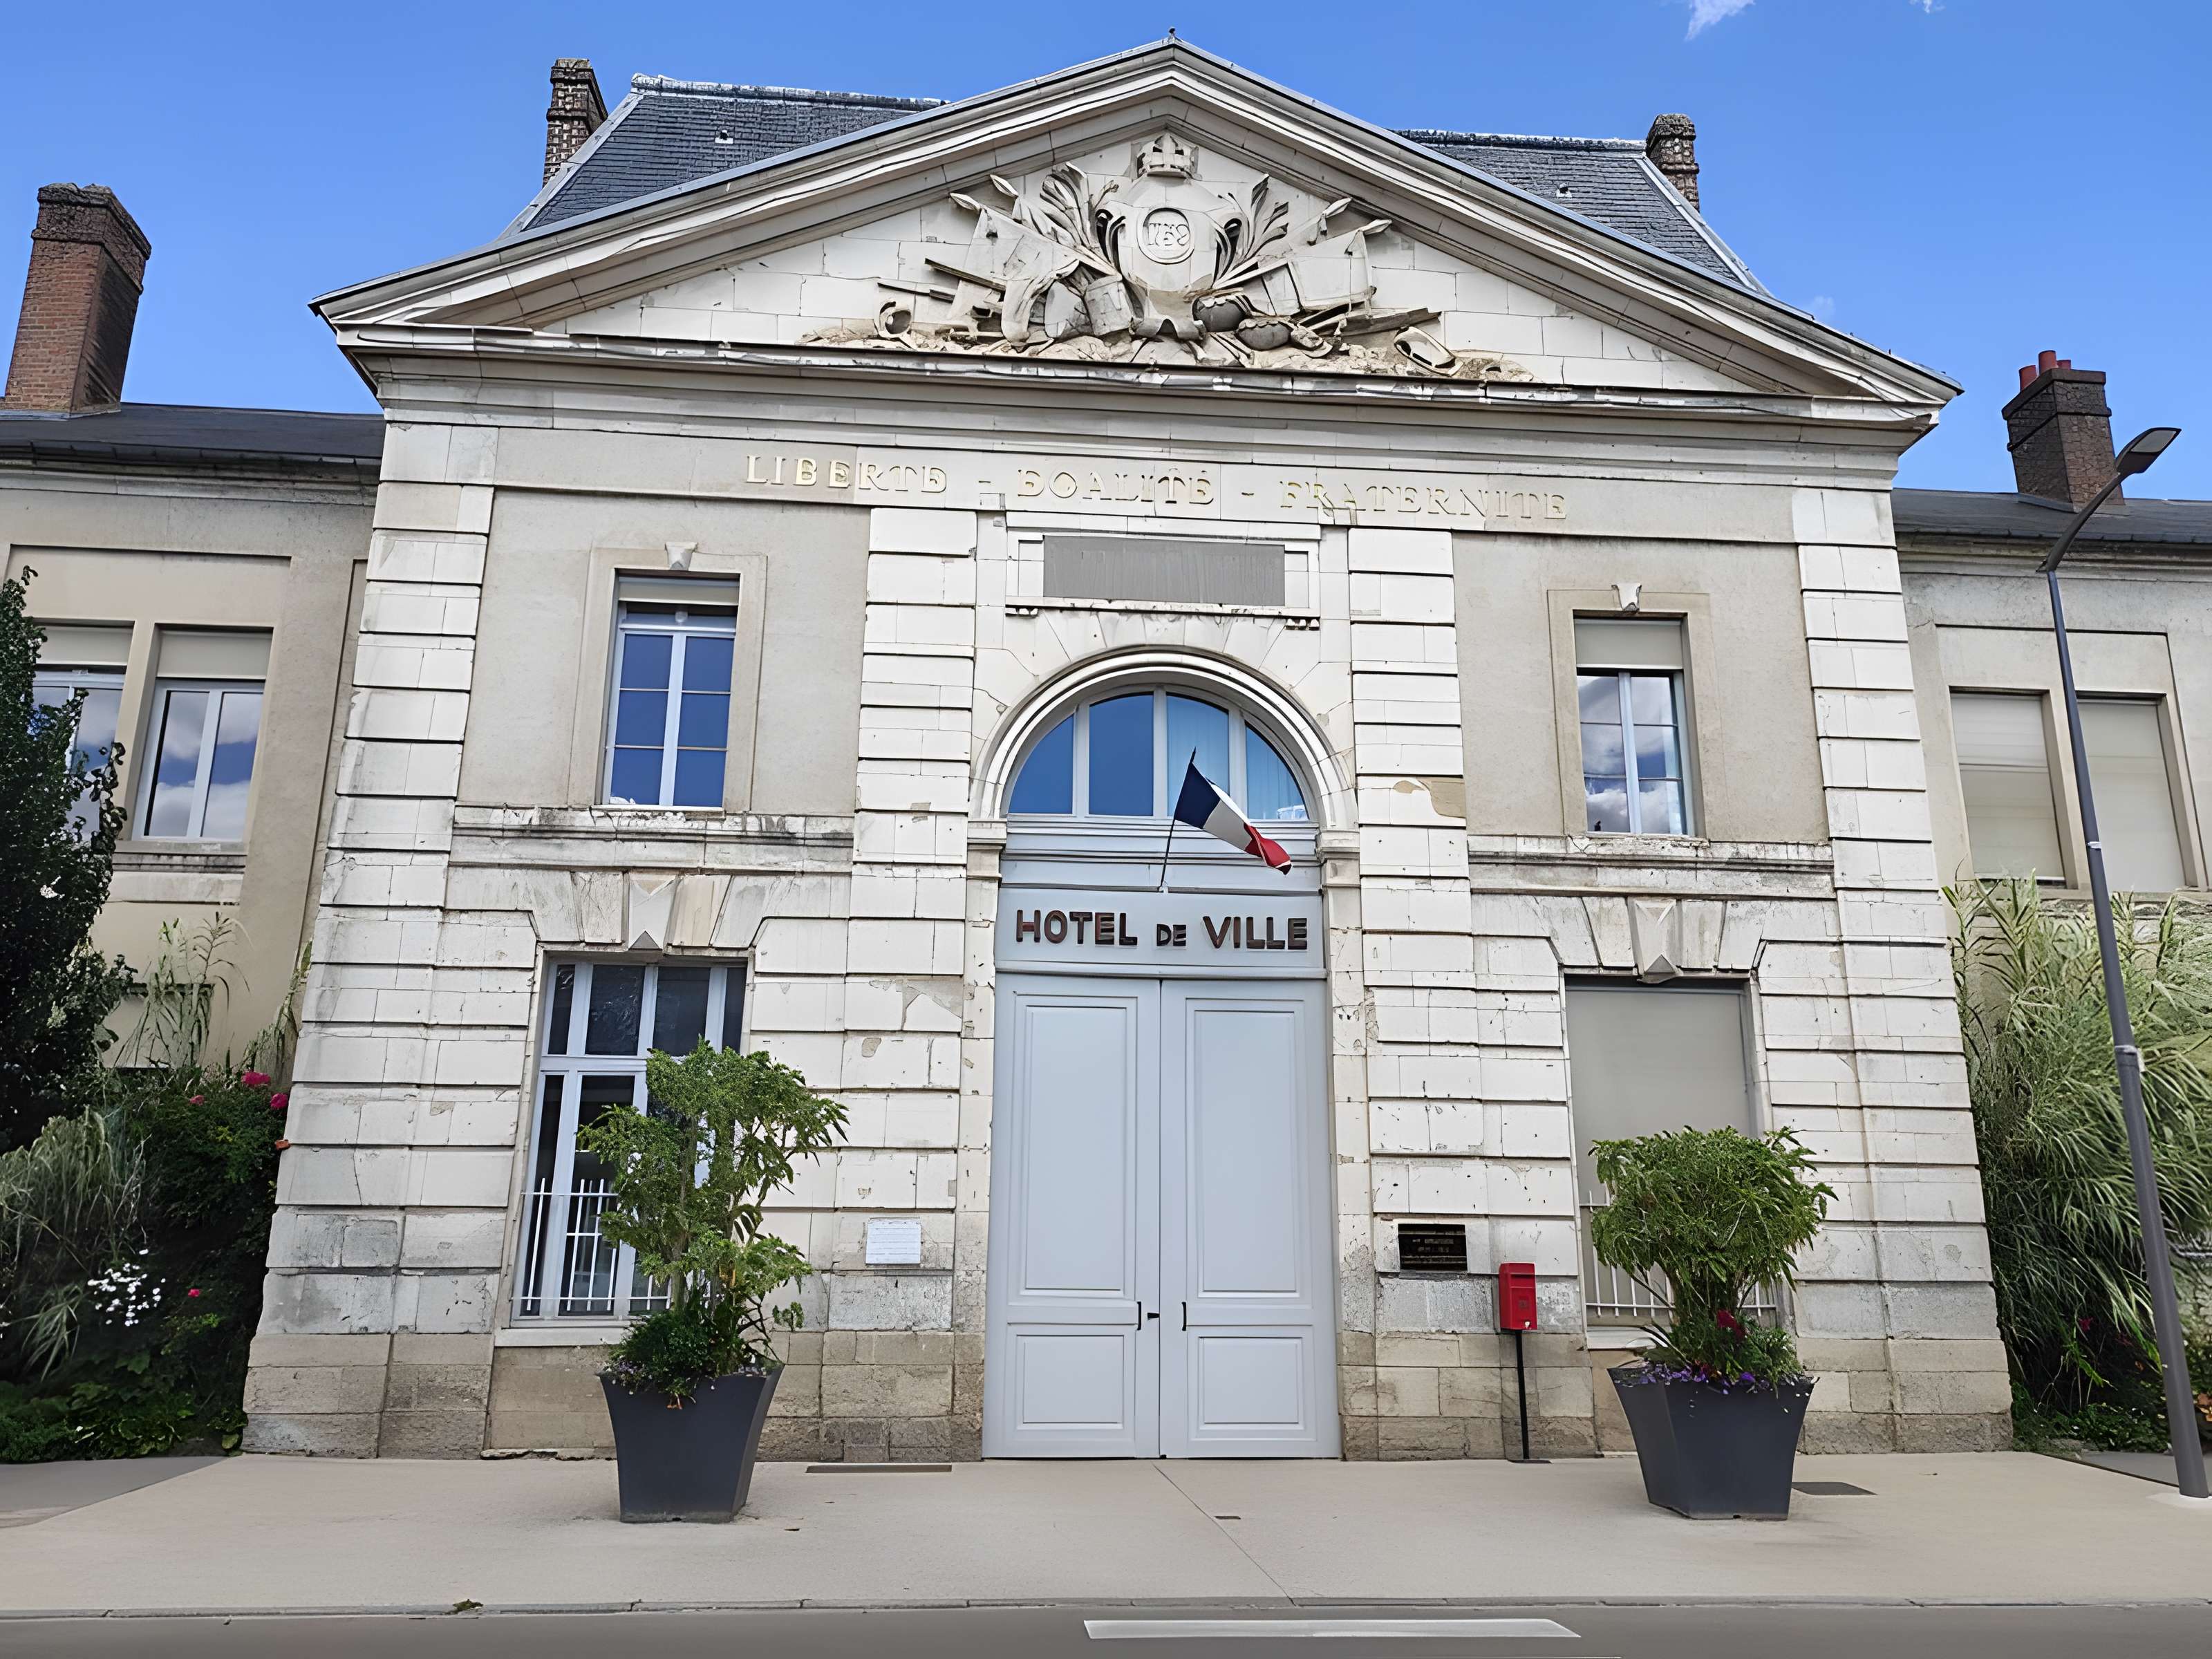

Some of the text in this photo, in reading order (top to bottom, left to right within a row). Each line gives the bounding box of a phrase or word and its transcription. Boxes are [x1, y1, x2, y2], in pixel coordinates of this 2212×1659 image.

[1015, 909, 1307, 950] HOTEL DE VILLE
